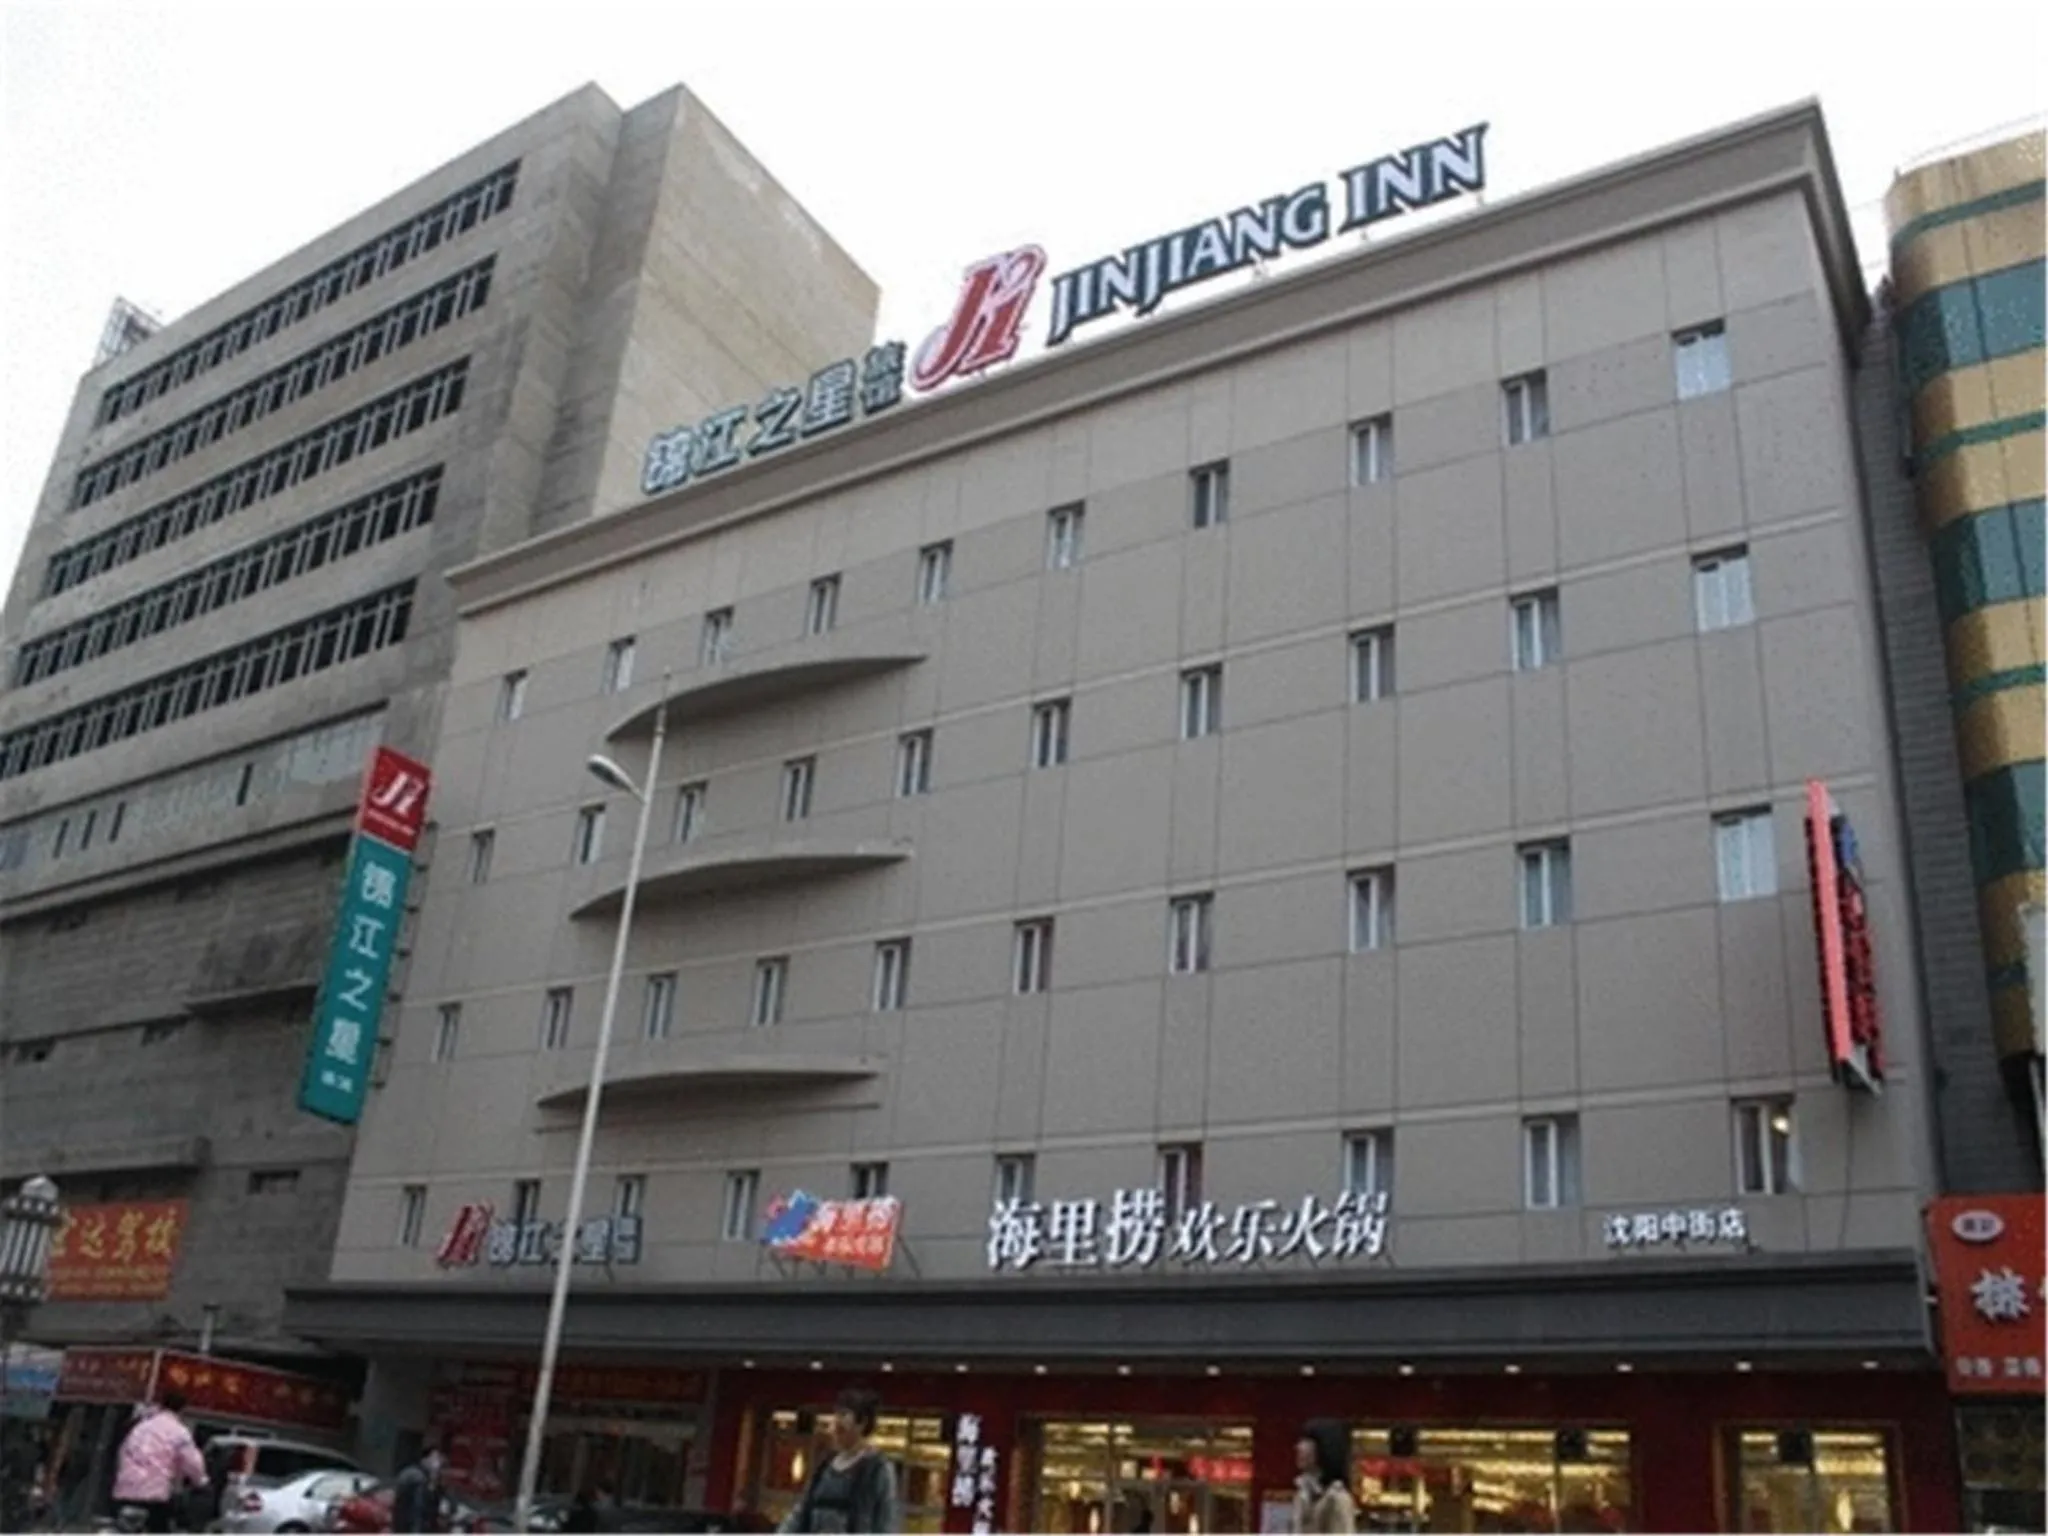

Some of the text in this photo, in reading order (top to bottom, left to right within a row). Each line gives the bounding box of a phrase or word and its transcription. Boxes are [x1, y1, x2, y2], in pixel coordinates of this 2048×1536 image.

[1047, 122, 1489, 346] JINJIANG INN
[641, 358, 857, 495] 锦江之星
[325, 859, 397, 1065] 锦江之星
[1603, 1208, 1746, 1244] 沈阳中街店
